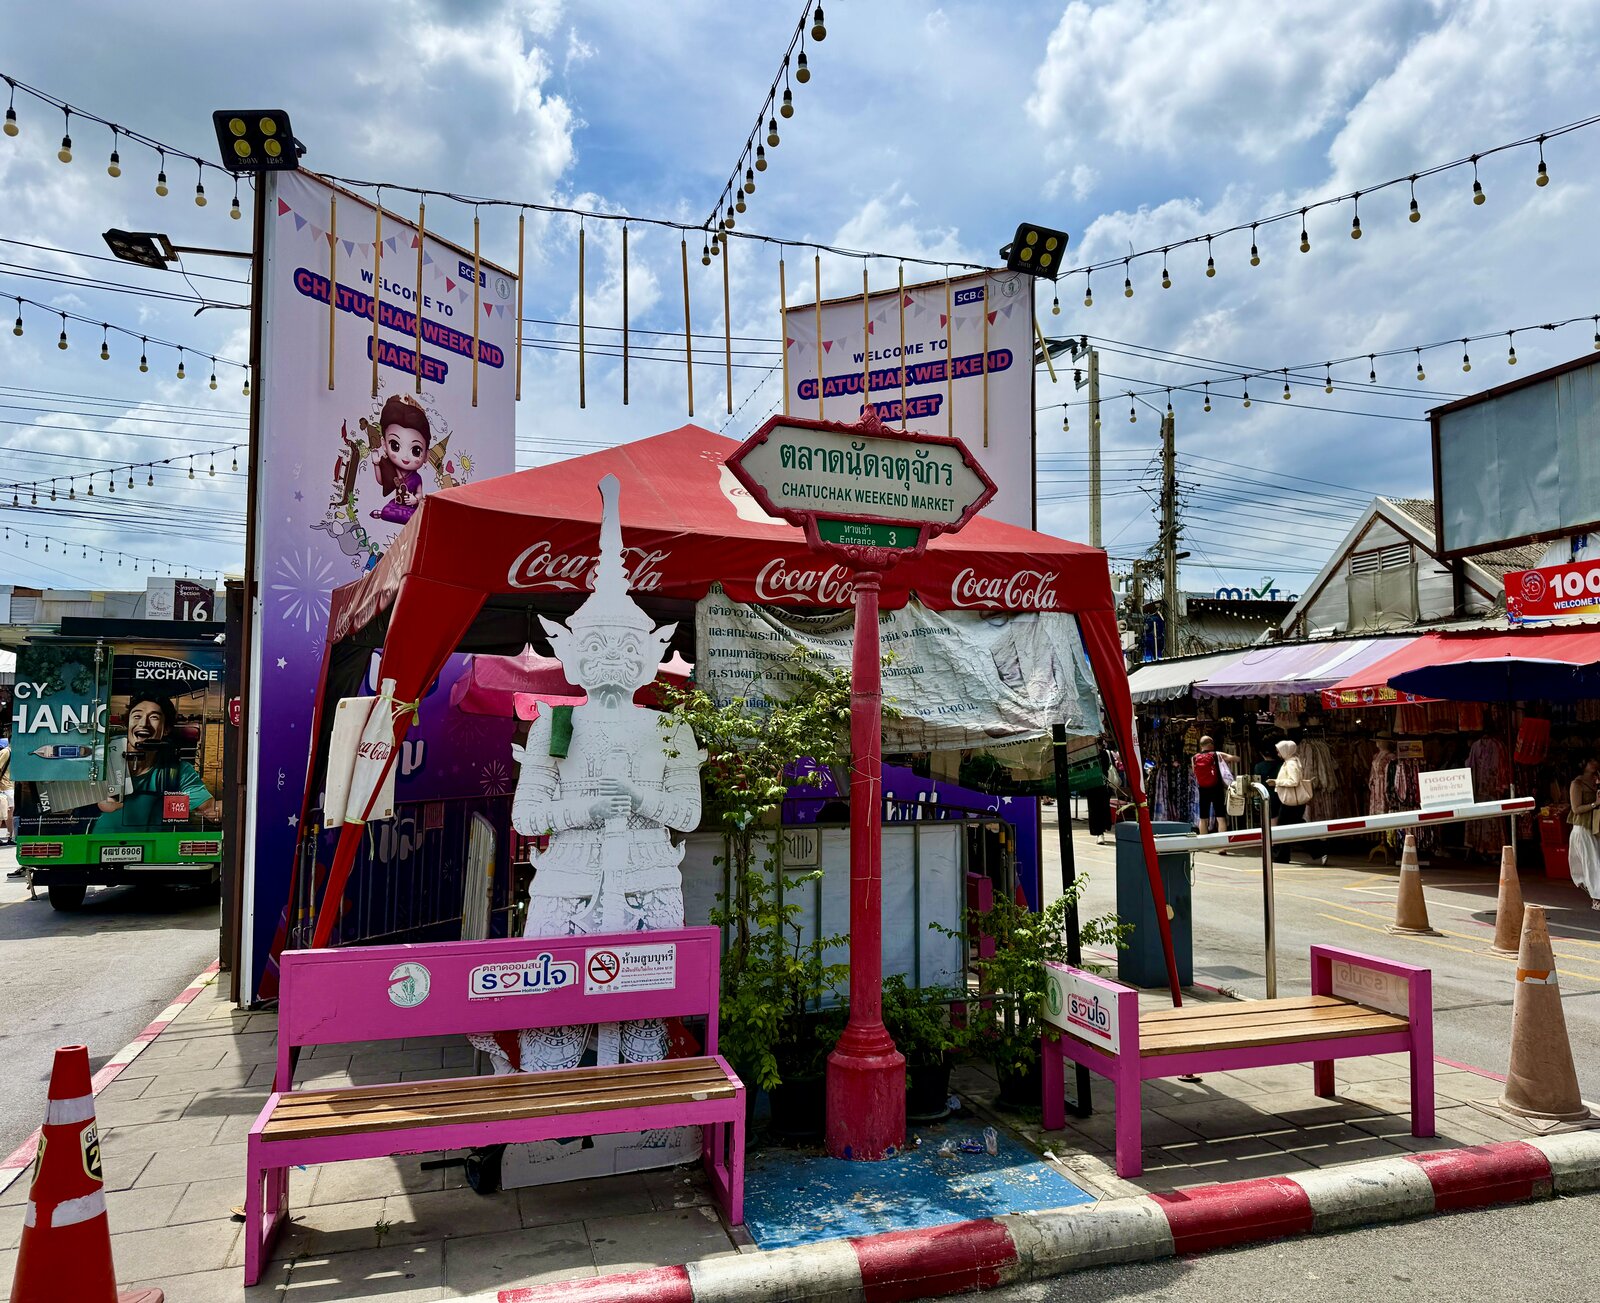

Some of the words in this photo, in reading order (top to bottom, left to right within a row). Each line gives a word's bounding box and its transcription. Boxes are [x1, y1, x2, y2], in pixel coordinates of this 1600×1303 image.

[360, 268, 432, 309] WELCOME
[436, 300, 453, 317] TO
[957, 291, 976, 303] SCB
[297, 272, 421, 336] CHATUCHAK
[371, 340, 446, 380] MARKET
[853, 345, 924, 364] WELCOME
[929, 339, 948, 351] TO
[800, 366, 910, 396] CHATUCHAK
[915, 352, 1009, 381] WEEKEND
[780, 441, 953, 491] ตลาดนัดจตุจักร
[782, 482, 852, 502] CHATUCHAK
[855, 489, 908, 507] WEEKEND
[911, 495, 955, 512] MARKET
[844, 524, 872, 536] ทางเข้า
[888, 531, 897, 546] 3
[839, 535, 876, 546] Entrance
[951, 567, 1060, 609] Coca-Cola
[183, 601, 208, 621] 16
[1553, 597, 1594, 610] WELCOME
[136, 660, 183, 668] CURRENCY
[135, 668, 218, 681] EXCHANGE
[1379, 688, 1397, 700] SALE
[39, 790, 51, 812] VISA
[121, 847, 141, 856] 6906
[622, 946, 674, 966] ห้ามสูบบุหรี่
